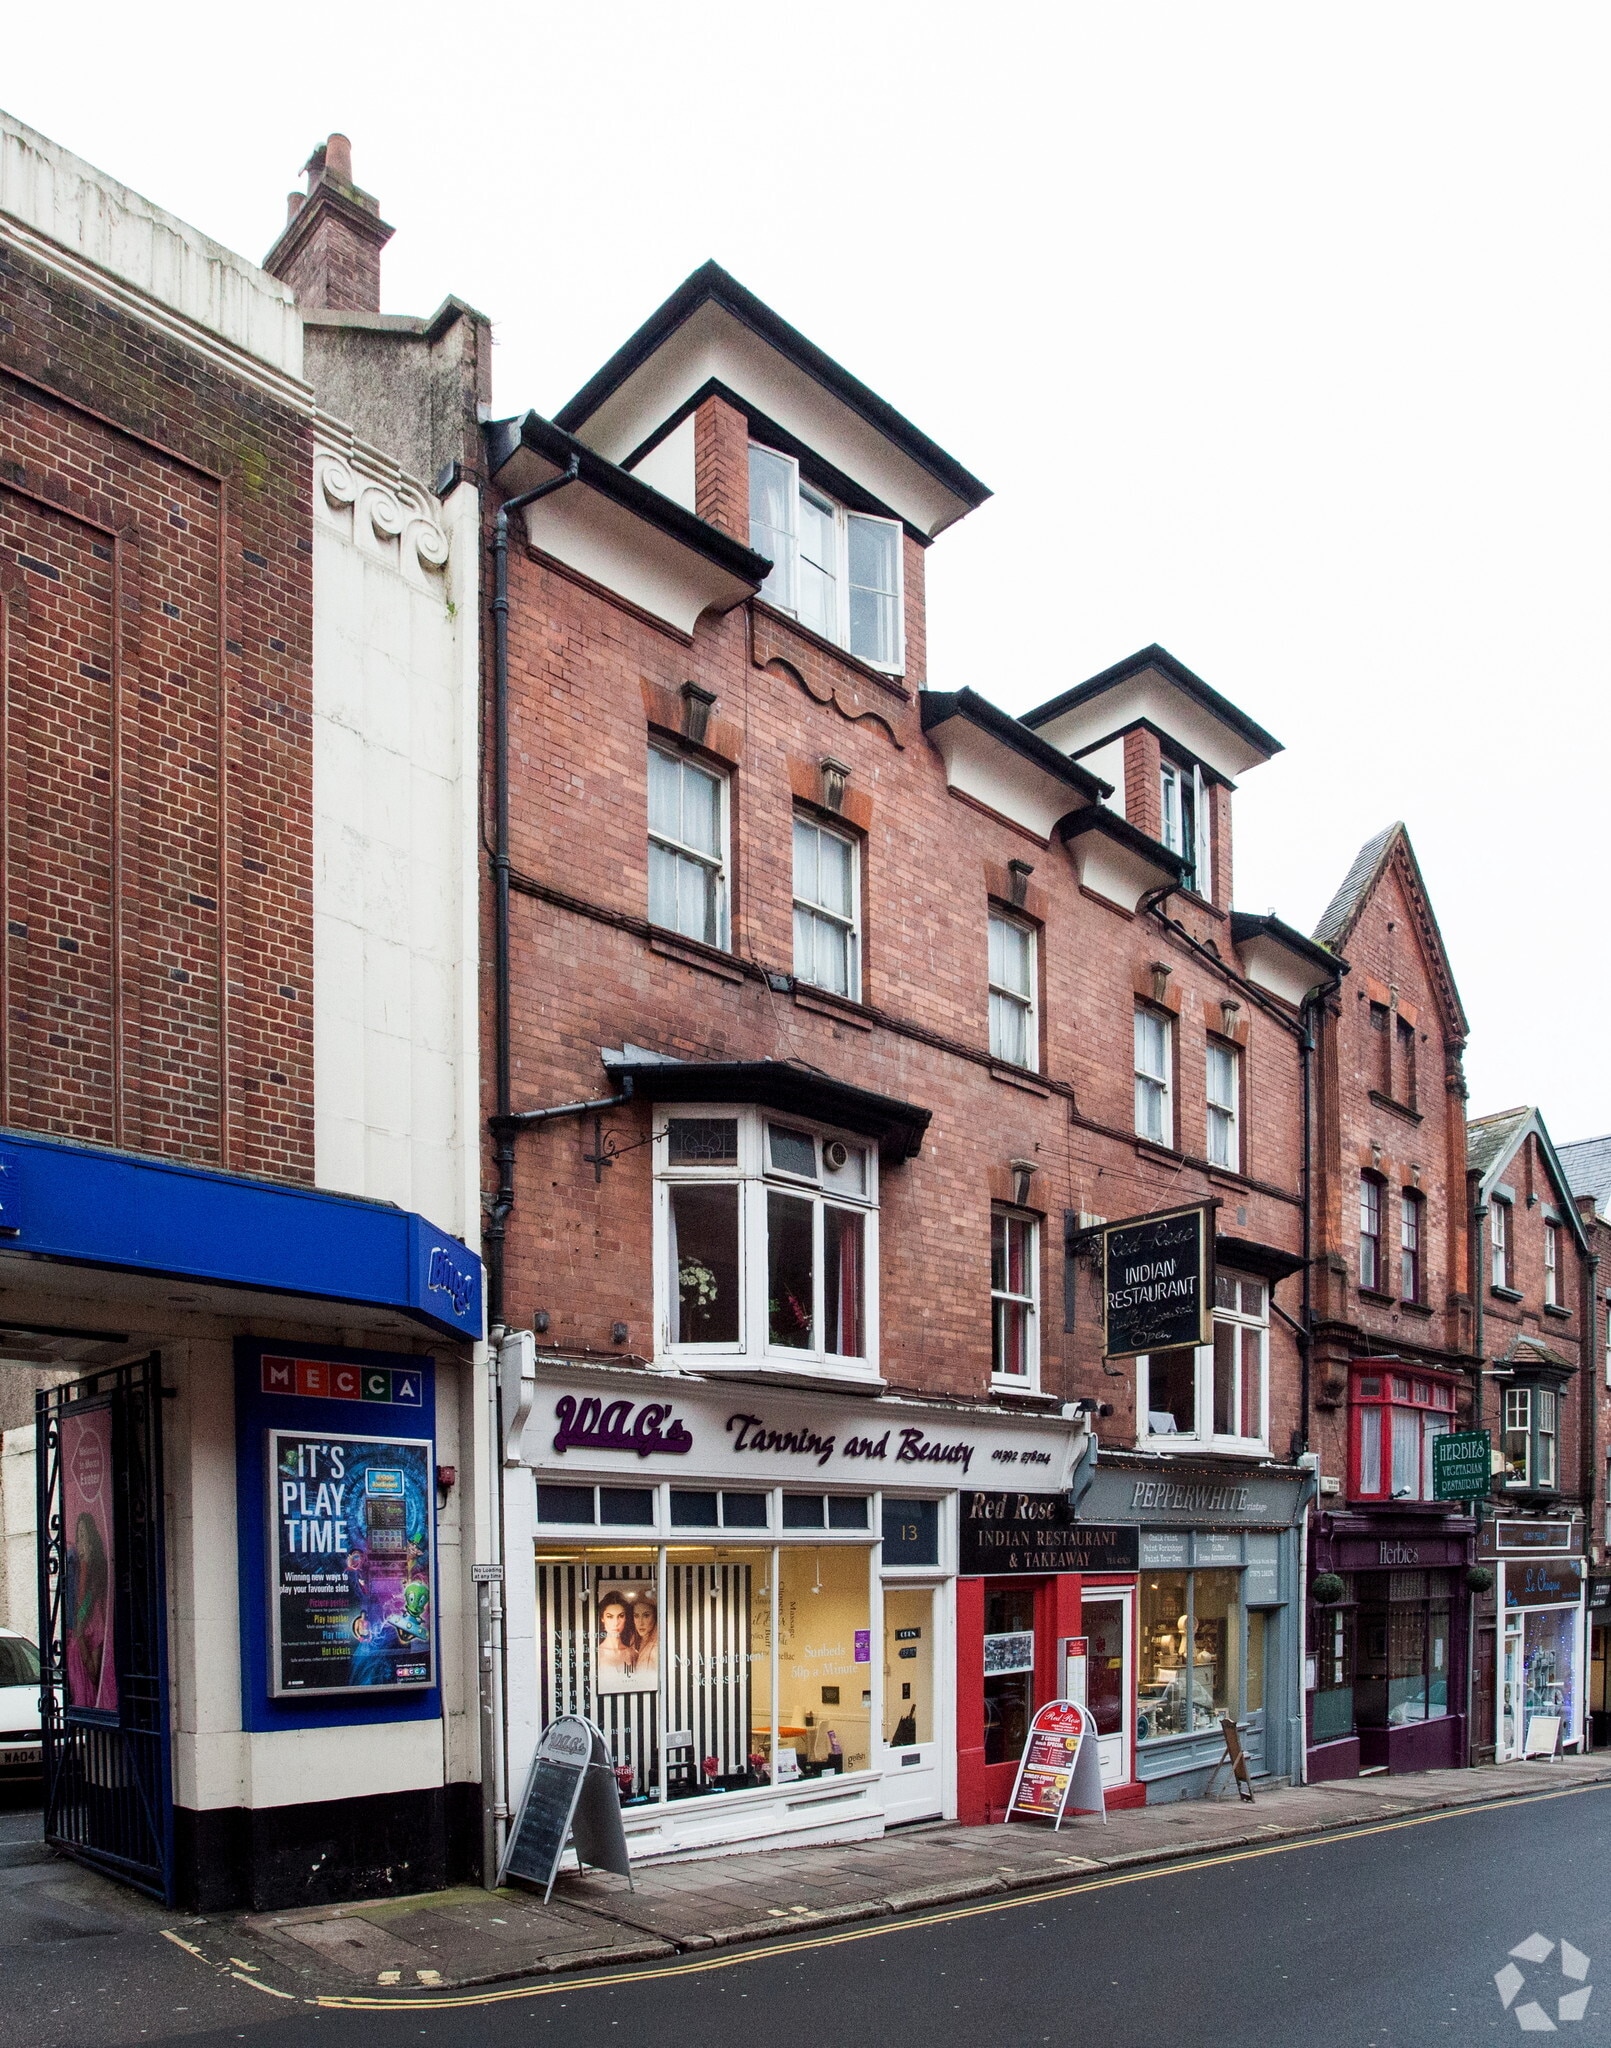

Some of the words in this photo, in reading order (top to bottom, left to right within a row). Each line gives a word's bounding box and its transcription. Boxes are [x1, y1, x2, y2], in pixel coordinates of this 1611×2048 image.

[1125, 1258, 1177, 1285] INDIAN
[1107, 1276, 1197, 1309] RESTAURANT
[270, 1365, 415, 1397] MECCA
[726, 1414, 836, 1465] Tanning
[844, 1431, 890, 1459] and
[896, 1428, 976, 1475] Beauty
[1440, 1440, 1485, 1461] HERBIES
[297, 1444, 345, 1479] IT'S
[1442, 1463, 1483, 1477] VEGETARIAN
[1441, 1478, 1484, 1492] RESTAURANT
[282, 1481, 345, 1516] PLAY
[1132, 1481, 1249, 1511] PEPPERWHITE
[969, 1492, 1007, 1519] Red
[1013, 1494, 1056, 1520] Rose
[284, 1520, 348, 1553] TIME
[901, 1525, 918, 1541] 13
[978, 1530, 1030, 1546] INDIAN
[1037, 1530, 1117, 1546] RESTAURANT
[1009, 1552, 1018, 1568] &
[1024, 1552, 1091, 1568] TAKEAWAY
[1380, 1541, 1419, 1564] Herbies
[285, 1572, 310, 1583] Winning
[311, 1574, 324, 1582] new
[326, 1573, 341, 1582] ways
[342, 1572, 349, 1581] to
[293, 1586, 307, 1595] your
[308, 1584, 334, 1593] favourite
[335, 1584, 349, 1592] slots
[313, 1615, 326, 1625] Play
[322, 1631, 335, 1640] Play
[321, 1647, 332, 1656] Hot
[332, 1647, 351, 1655] tickets
[804, 1643, 845, 1658] Sunbeds
[674, 1654, 691, 1668] No
[695, 1650, 764, 1669] Appointment
[823, 1662, 859, 1676] Minute
[692, 1673, 749, 1687] Necessary
[1044, 1712, 1062, 1721] Red
[1062, 1714, 1081, 1724] Rose
